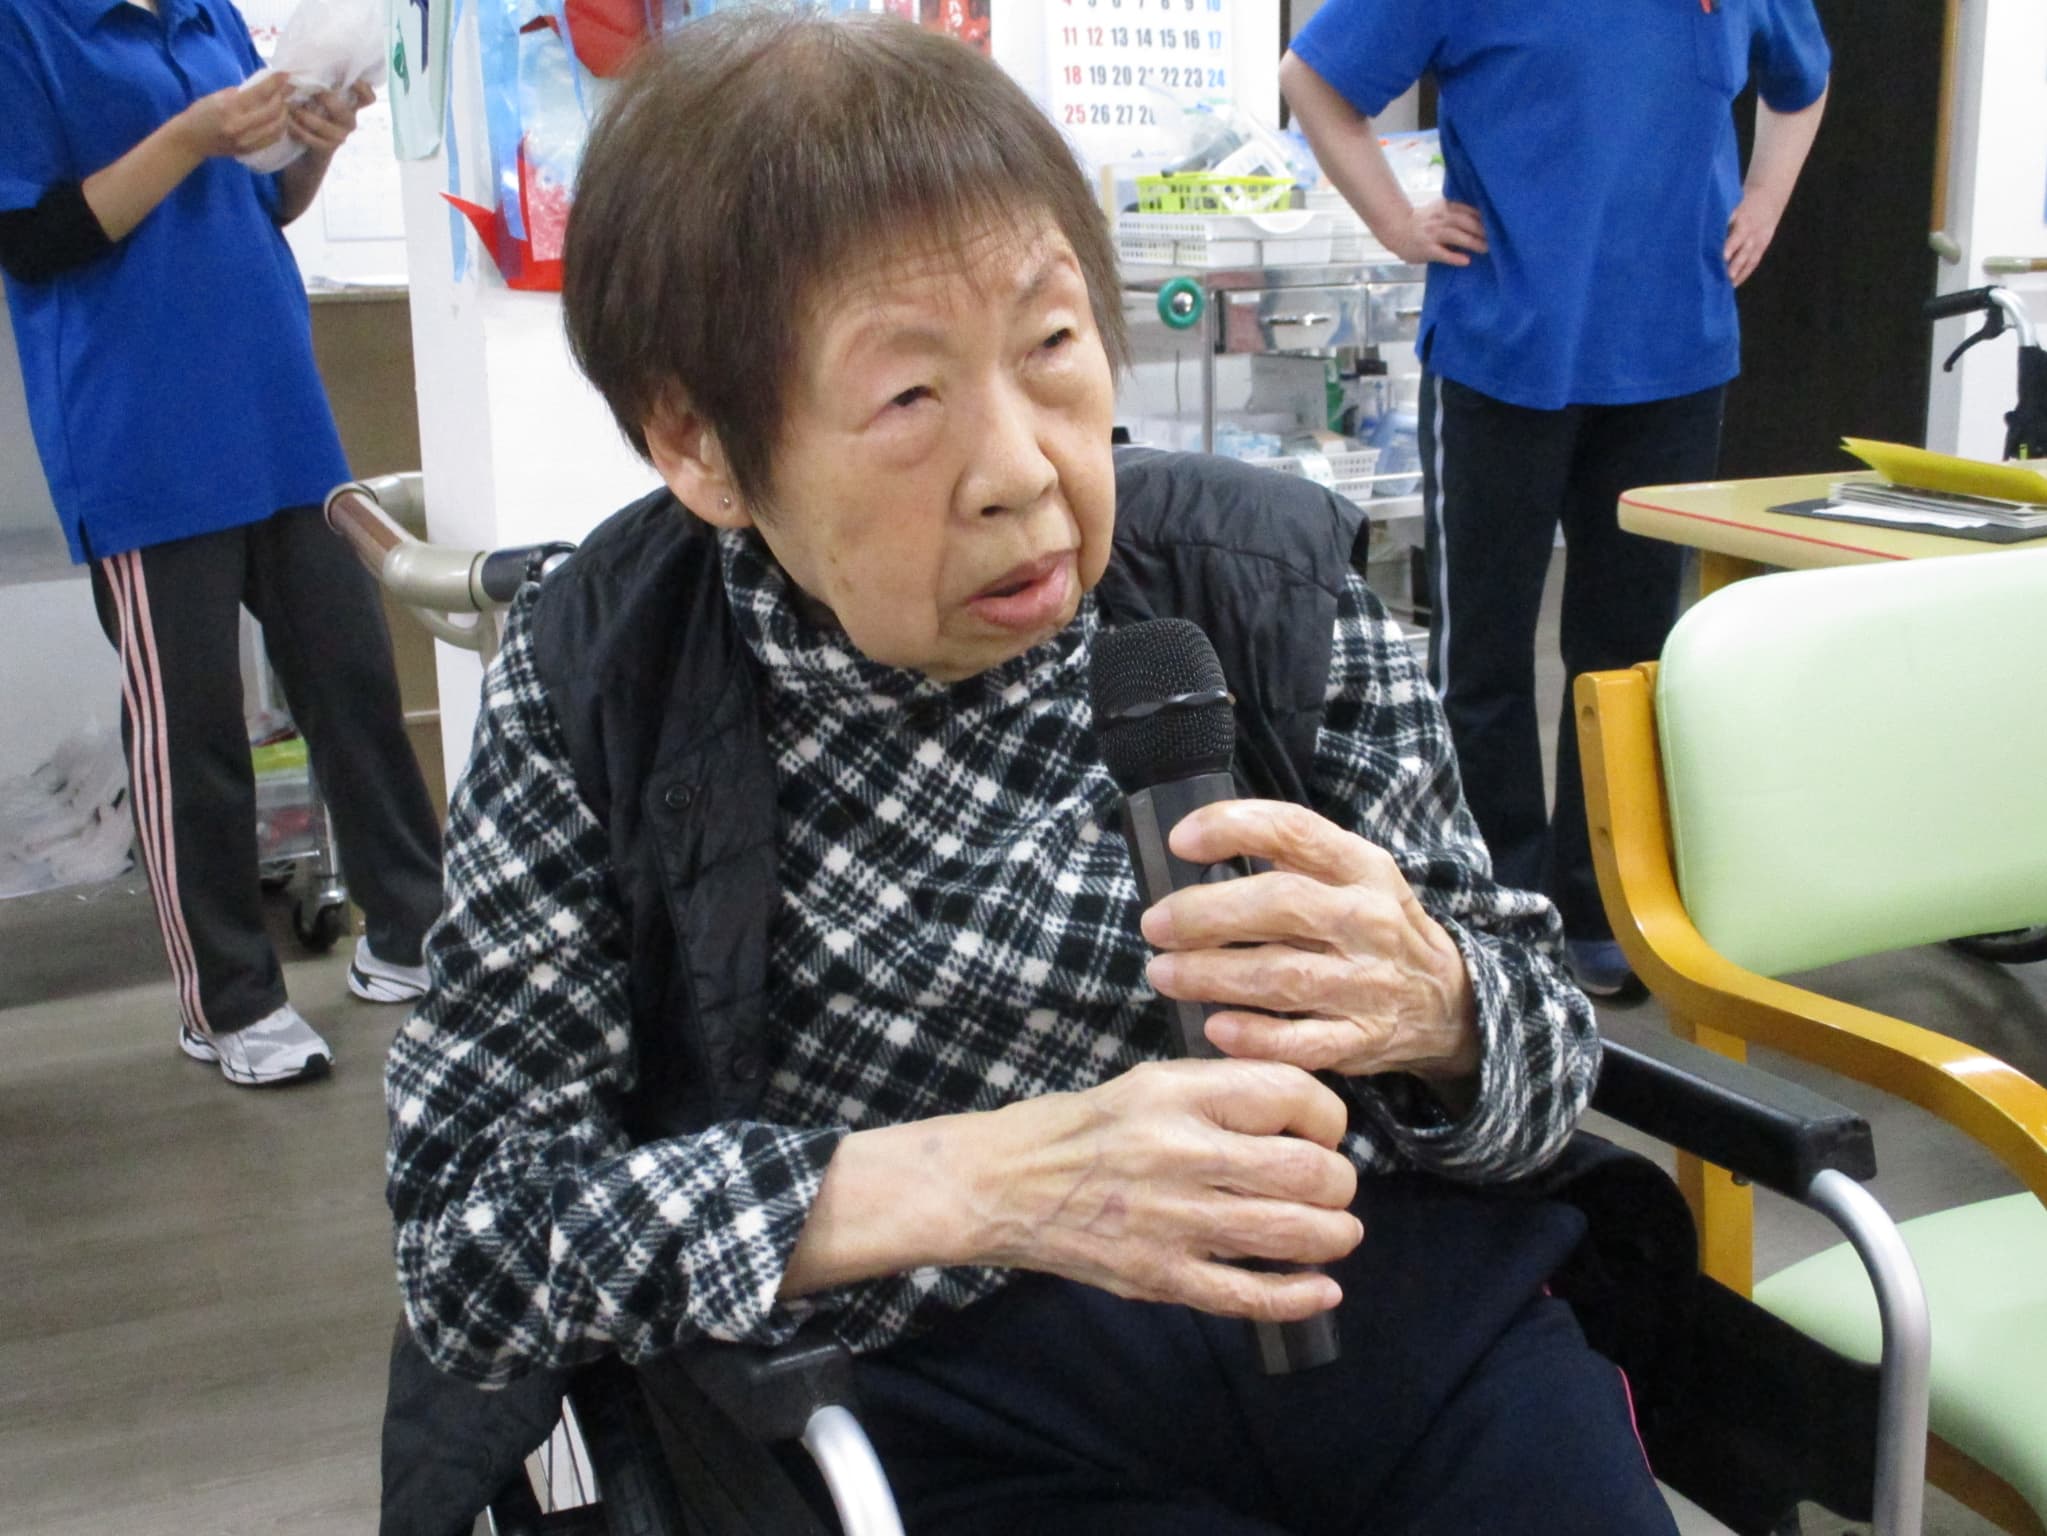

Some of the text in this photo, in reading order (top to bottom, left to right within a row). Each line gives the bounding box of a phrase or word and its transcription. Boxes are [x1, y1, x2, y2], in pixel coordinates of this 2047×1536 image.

[1063, 26, 1222, 49] 11 12 13 14 15 16 17
[1064, 65, 1082, 85] 18
[1089, 65, 1106, 85] 19
[1112, 66, 1132, 86] 20
[1161, 67, 1179, 87] 22
[1184, 68, 1202, 88] 23
[1208, 68, 1225, 87] 24
[1065, 104, 1086, 124] 25
[1091, 105, 1110, 124] 26
[1116, 105, 1133, 124] 27
